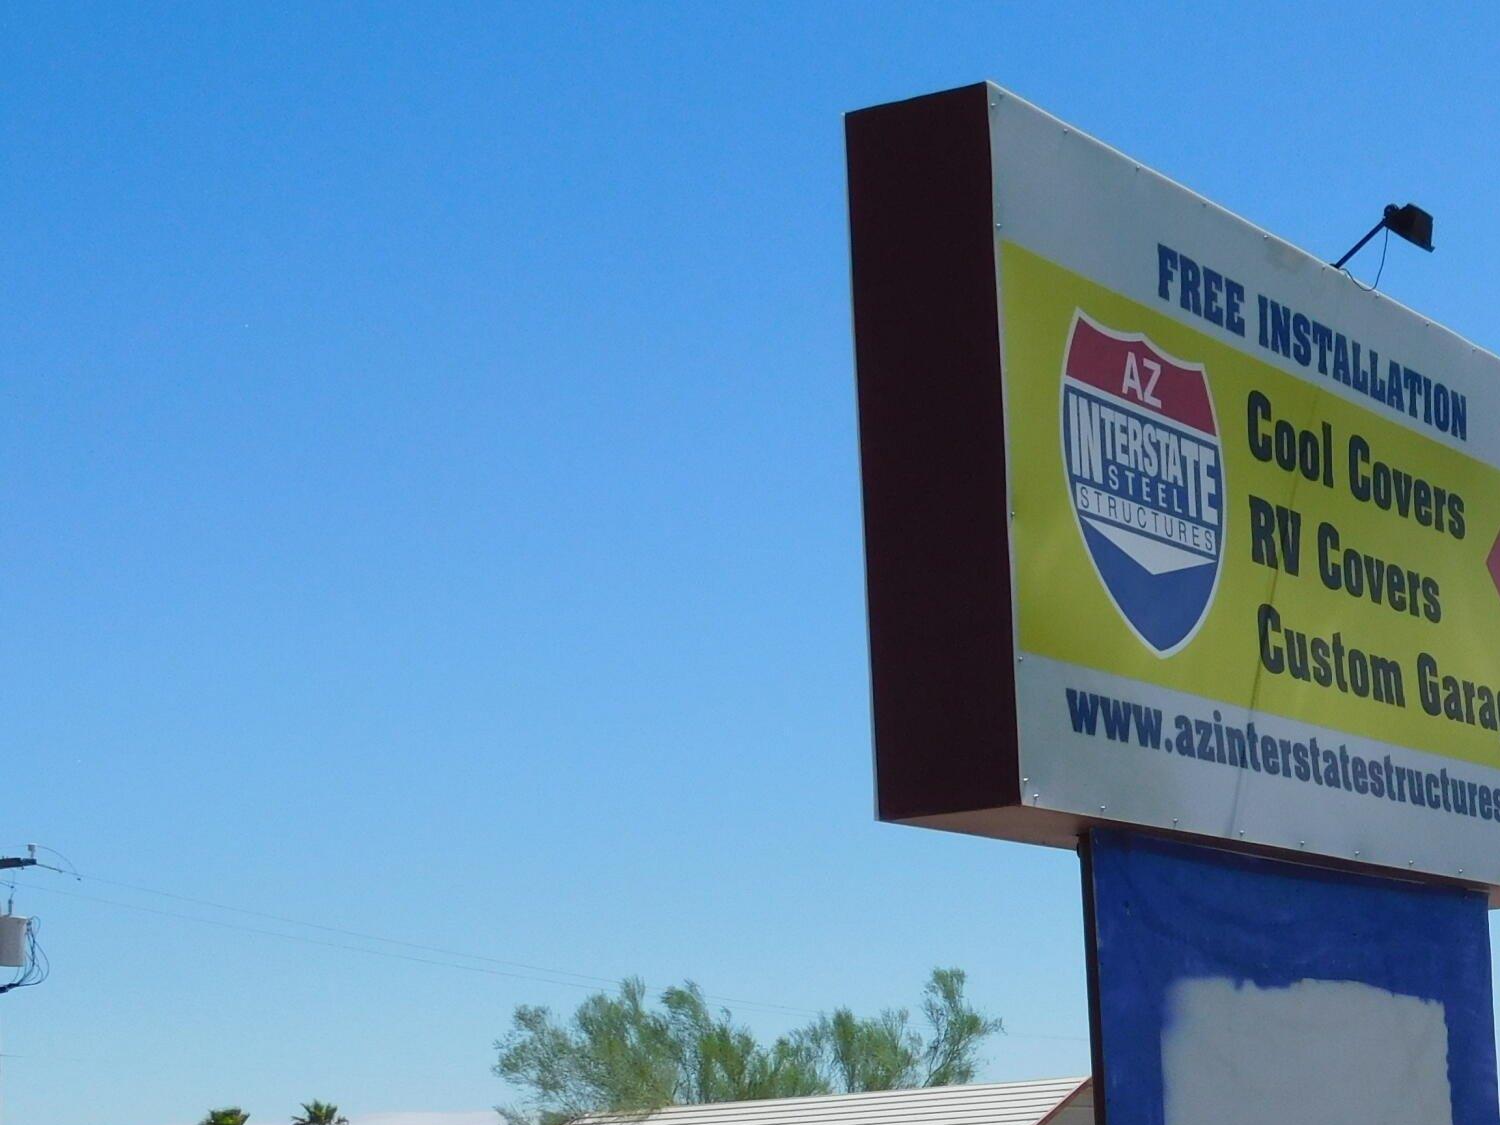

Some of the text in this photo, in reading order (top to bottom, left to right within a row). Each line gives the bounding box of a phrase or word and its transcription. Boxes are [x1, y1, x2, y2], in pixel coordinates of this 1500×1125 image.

[1122, 351, 1162, 409] AZ
[1157, 243, 1468, 441] FREE INSTALLATION
[1069, 392, 1218, 526] INTERSTATE
[1108, 465, 1183, 514] STEEL
[1247, 390, 1466, 540] Cool Covers
[1080, 486, 1213, 552] STRUCTURES
[1249, 494, 1442, 624] RV Covers
[1257, 603, 1406, 708] Custom
